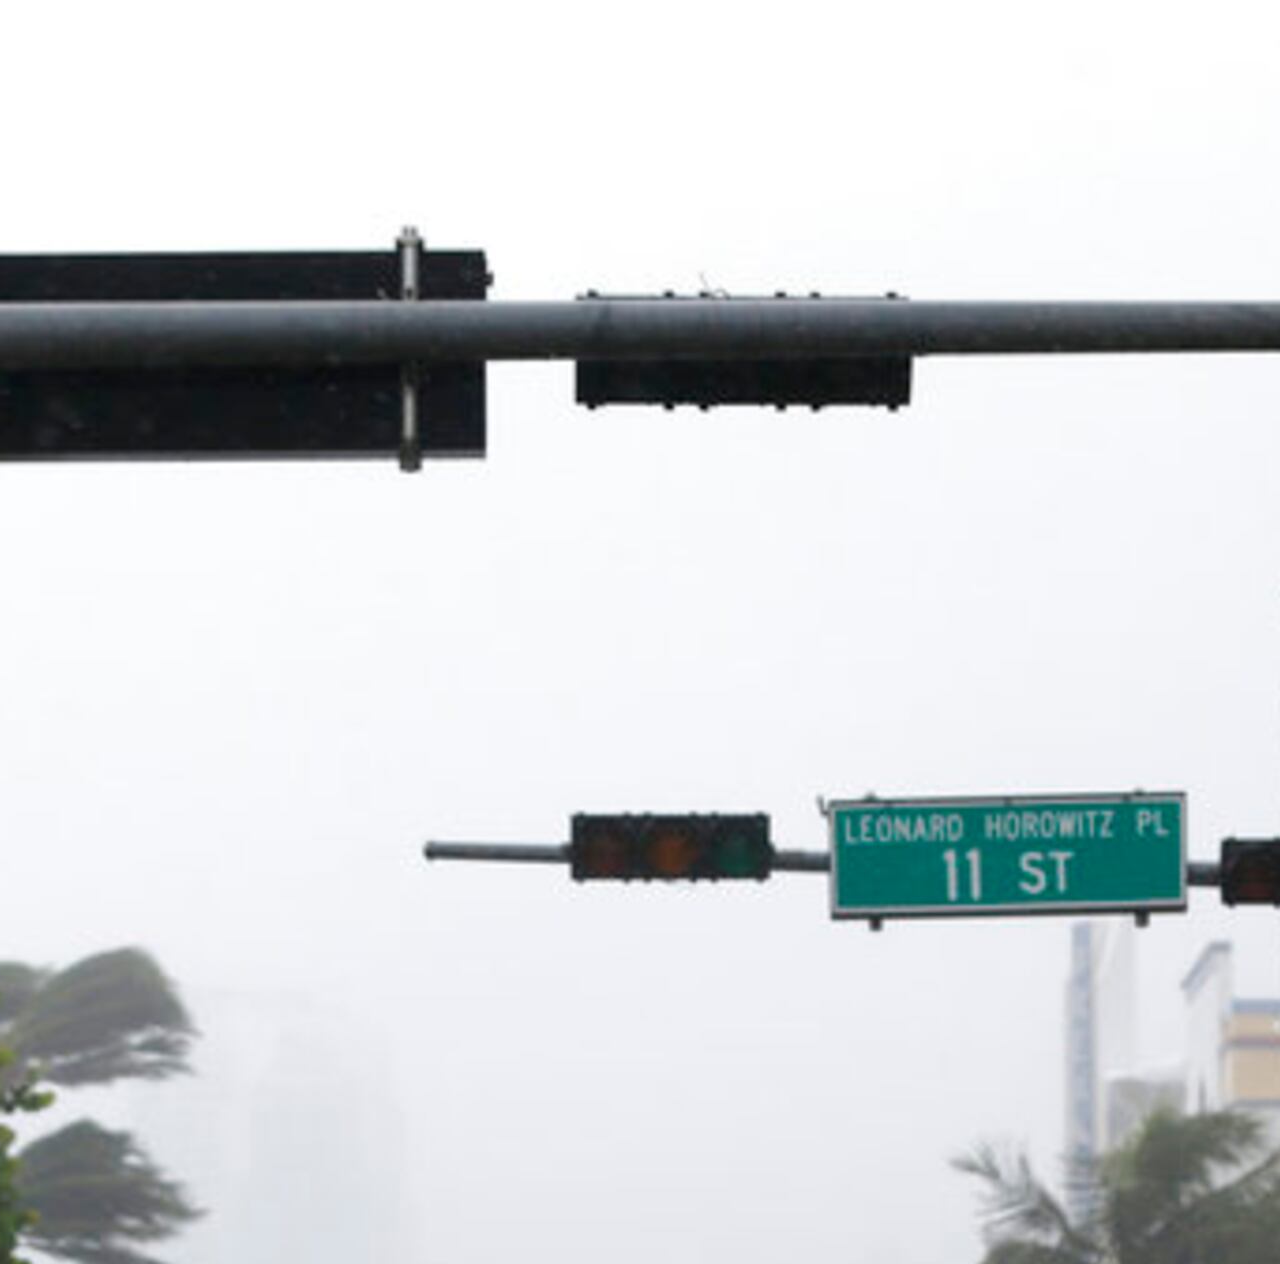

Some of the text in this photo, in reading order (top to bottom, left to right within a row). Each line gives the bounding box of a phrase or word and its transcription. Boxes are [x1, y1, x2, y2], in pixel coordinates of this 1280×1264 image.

[844, 808, 1170, 843] LEONARD HOROWITZ PL
[943, 847, 1074, 901] 11 ST
